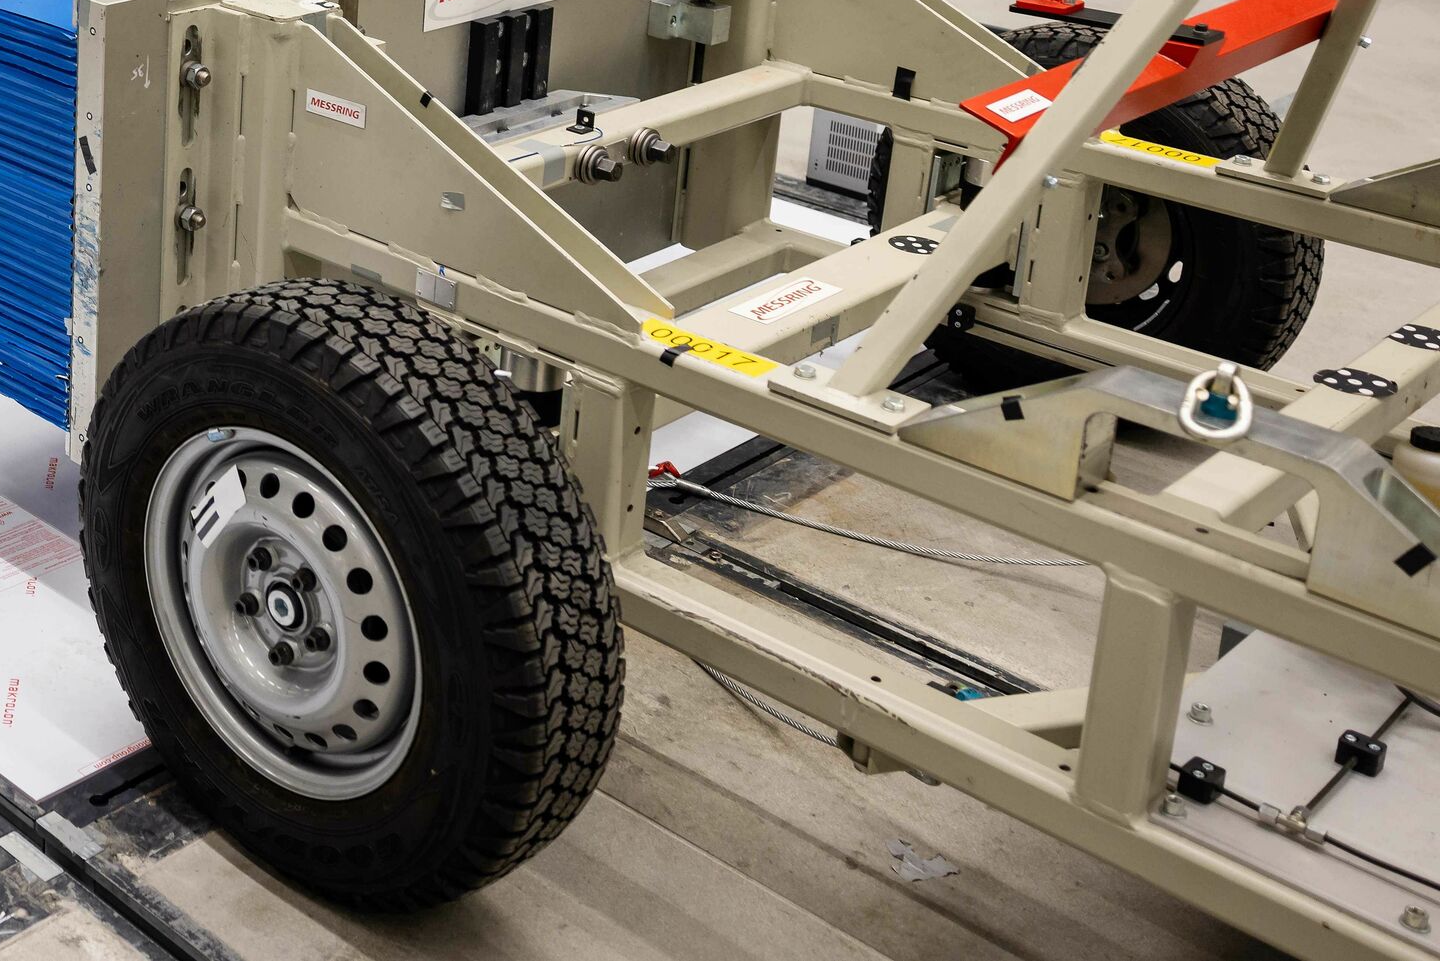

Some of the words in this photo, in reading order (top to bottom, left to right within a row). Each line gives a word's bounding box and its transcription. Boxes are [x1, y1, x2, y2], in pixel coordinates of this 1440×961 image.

[310, 97, 361, 120] MESSRING
[998, 95, 1041, 116] MESSRING
[749, 283, 823, 319] MESSRING
[650, 328, 758, 367] 00017
[2, 678, 20, 728] makrolon
